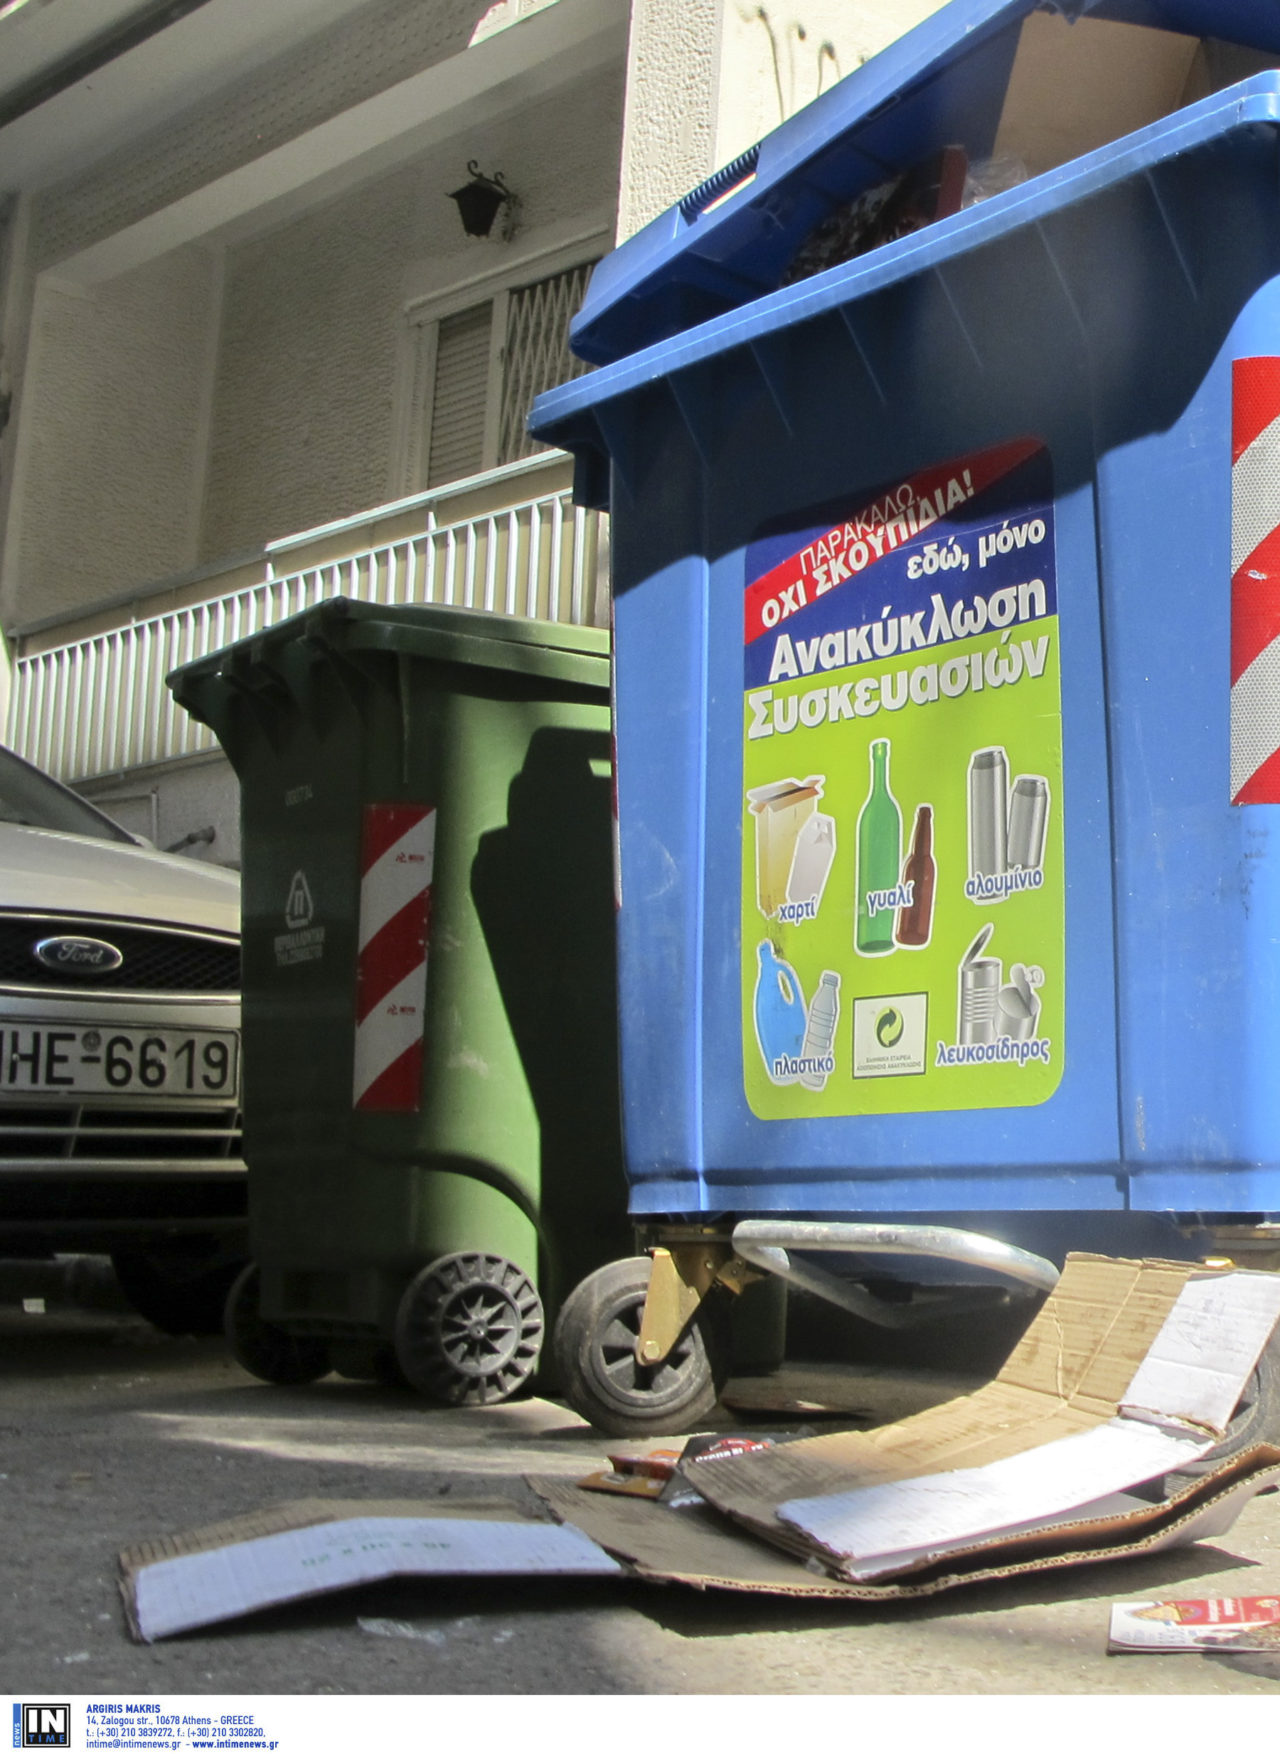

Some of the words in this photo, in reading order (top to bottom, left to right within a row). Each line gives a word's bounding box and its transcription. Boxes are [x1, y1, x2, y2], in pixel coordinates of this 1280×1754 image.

[800, 484, 922, 575] ΠΑΡΑΚΑΛΩ,
[761, 579, 807, 628] ΟΧΙ
[812, 469, 975, 597] ΣΚΟΥΠΙΔΙΑ!
[907, 537, 970, 580] εδώ,
[979, 519, 1046, 568] μόνο
[768, 578, 1047, 682] Ανακύκλωση
[748, 631, 1049, 740] Συσκευασιών
[867, 882, 914, 915] γυαλί
[965, 868, 1042, 896] αλουμίνιο
[779, 899, 816, 923] χαρτί
[57, 942, 103, 963] Ford
[774, 1052, 835, 1076] πλαστικό
[937, 1037, 1049, 1065] λευκοσίδηρος
